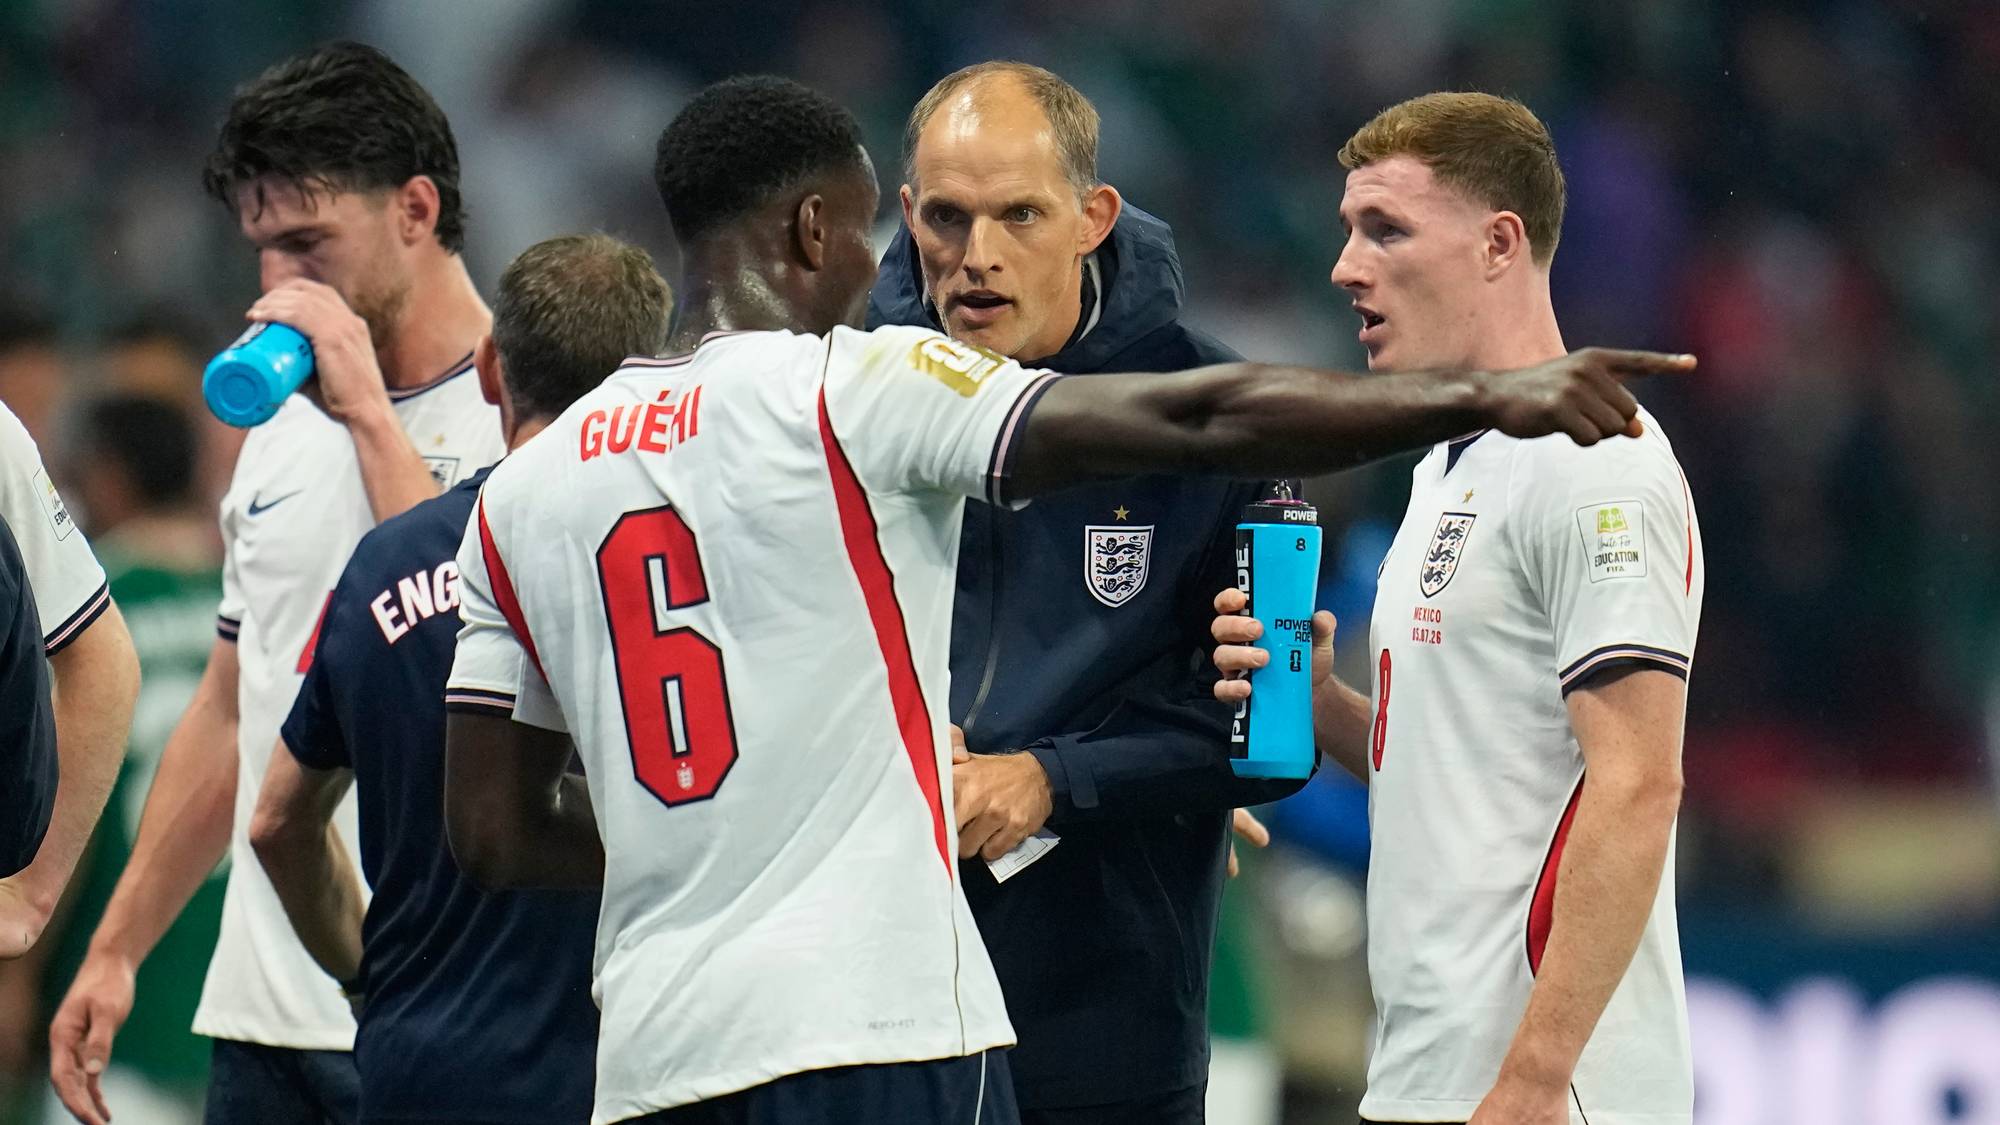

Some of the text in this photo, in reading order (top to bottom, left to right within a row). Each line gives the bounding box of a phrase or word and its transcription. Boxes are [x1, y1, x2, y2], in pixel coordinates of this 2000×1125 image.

[1296, 537, 1306, 551] 8
[1594, 550, 1639, 567] EDUCATION
[1606, 565, 1625, 573] FIFA
[1413, 606, 1442, 623] MEXICO
[1412, 626, 1442, 645] 05.07.26
[596, 504, 739, 808] 6
[1373, 648, 1391, 772] 8
